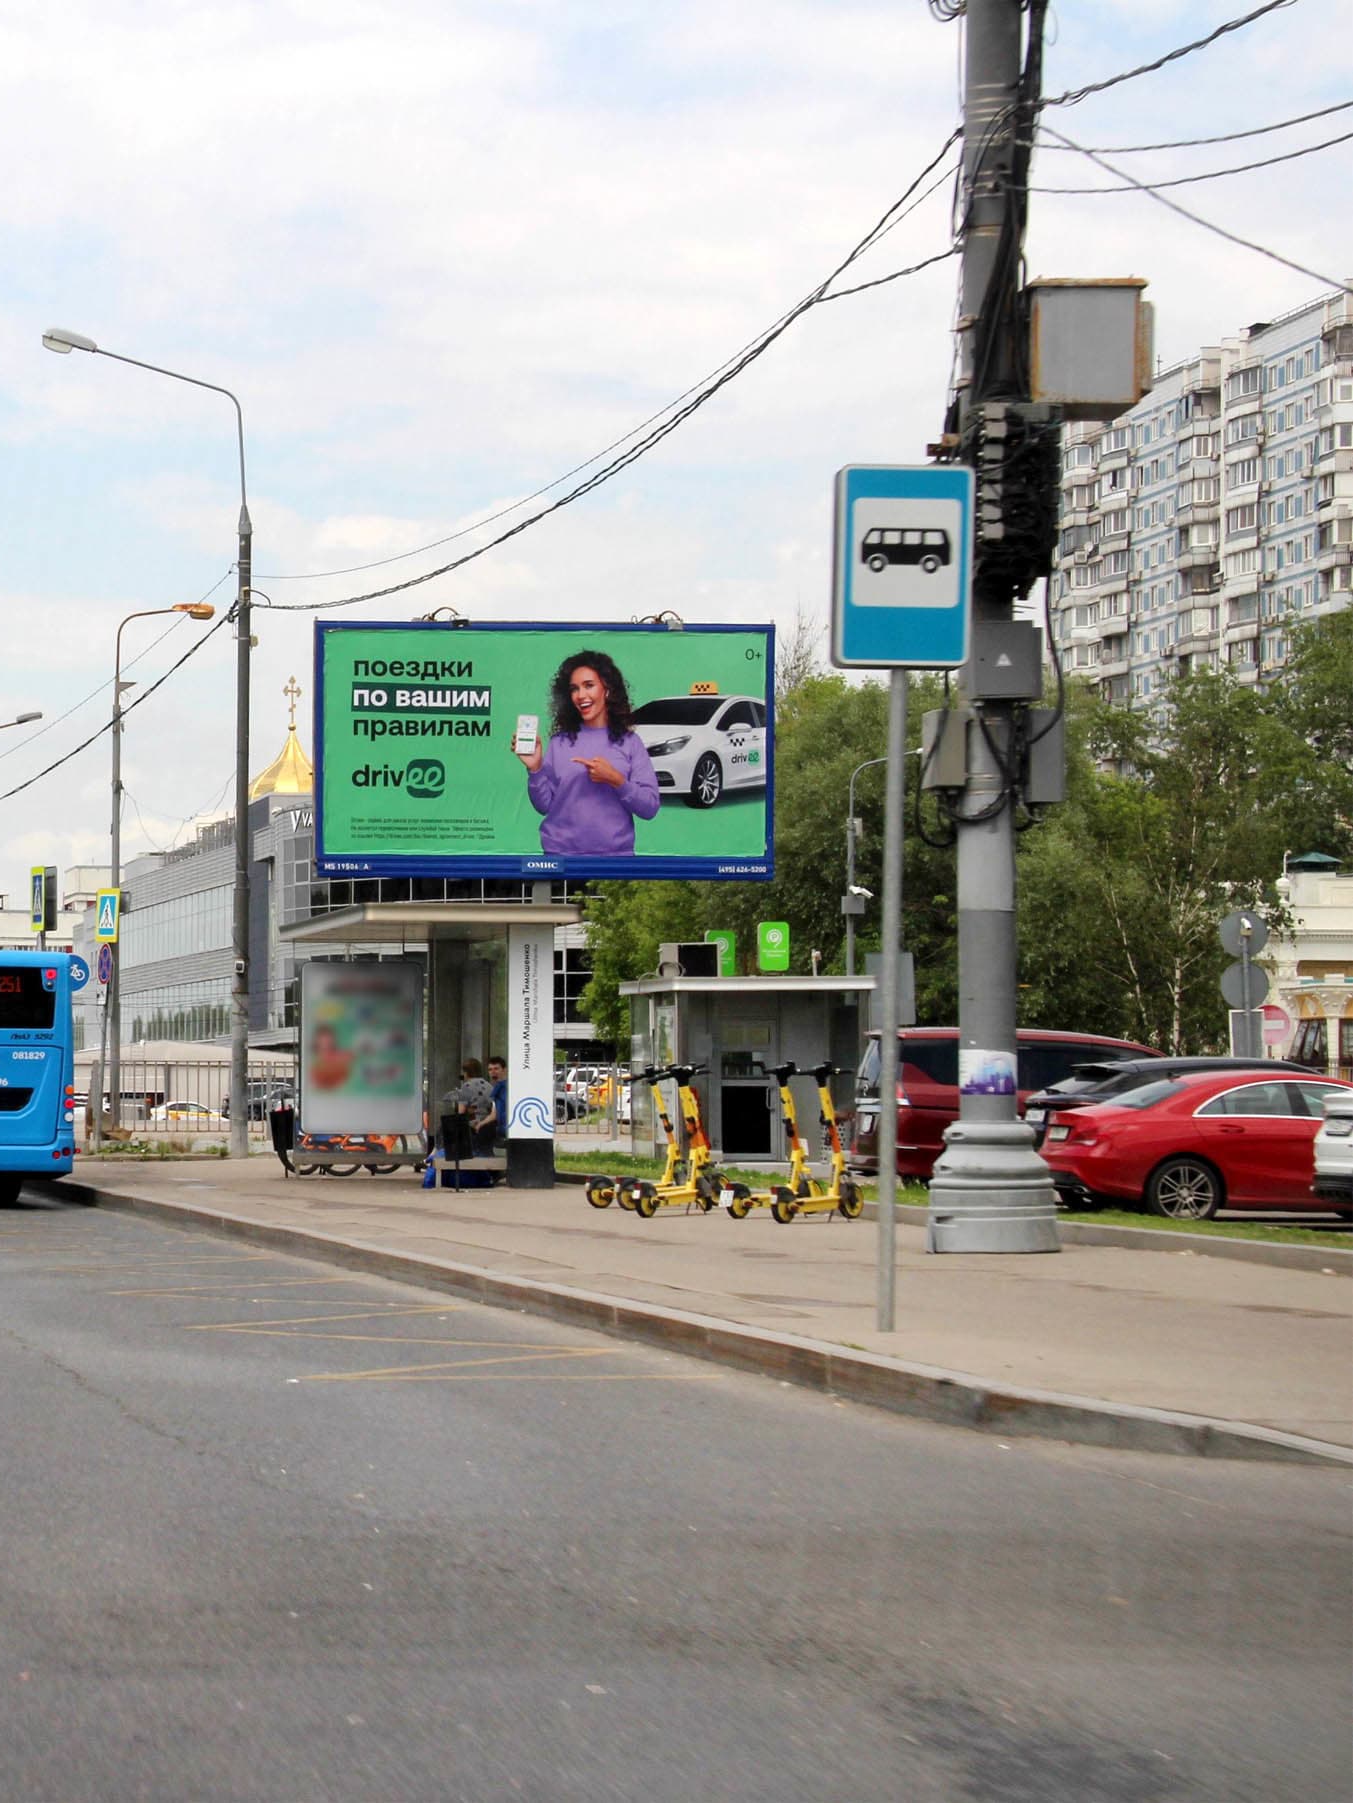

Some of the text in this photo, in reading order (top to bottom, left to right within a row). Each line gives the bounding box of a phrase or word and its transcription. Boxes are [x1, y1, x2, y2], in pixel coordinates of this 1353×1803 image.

[353, 660, 473, 681] поездки
[353, 689, 490, 708] по вашим
[353, 719, 491, 742] правилам
[351, 758, 446, 799] drivee
[522, 943, 531, 1070] Улица Маршала Тимошенко
[12, 1050, 46, 1061] 081829
